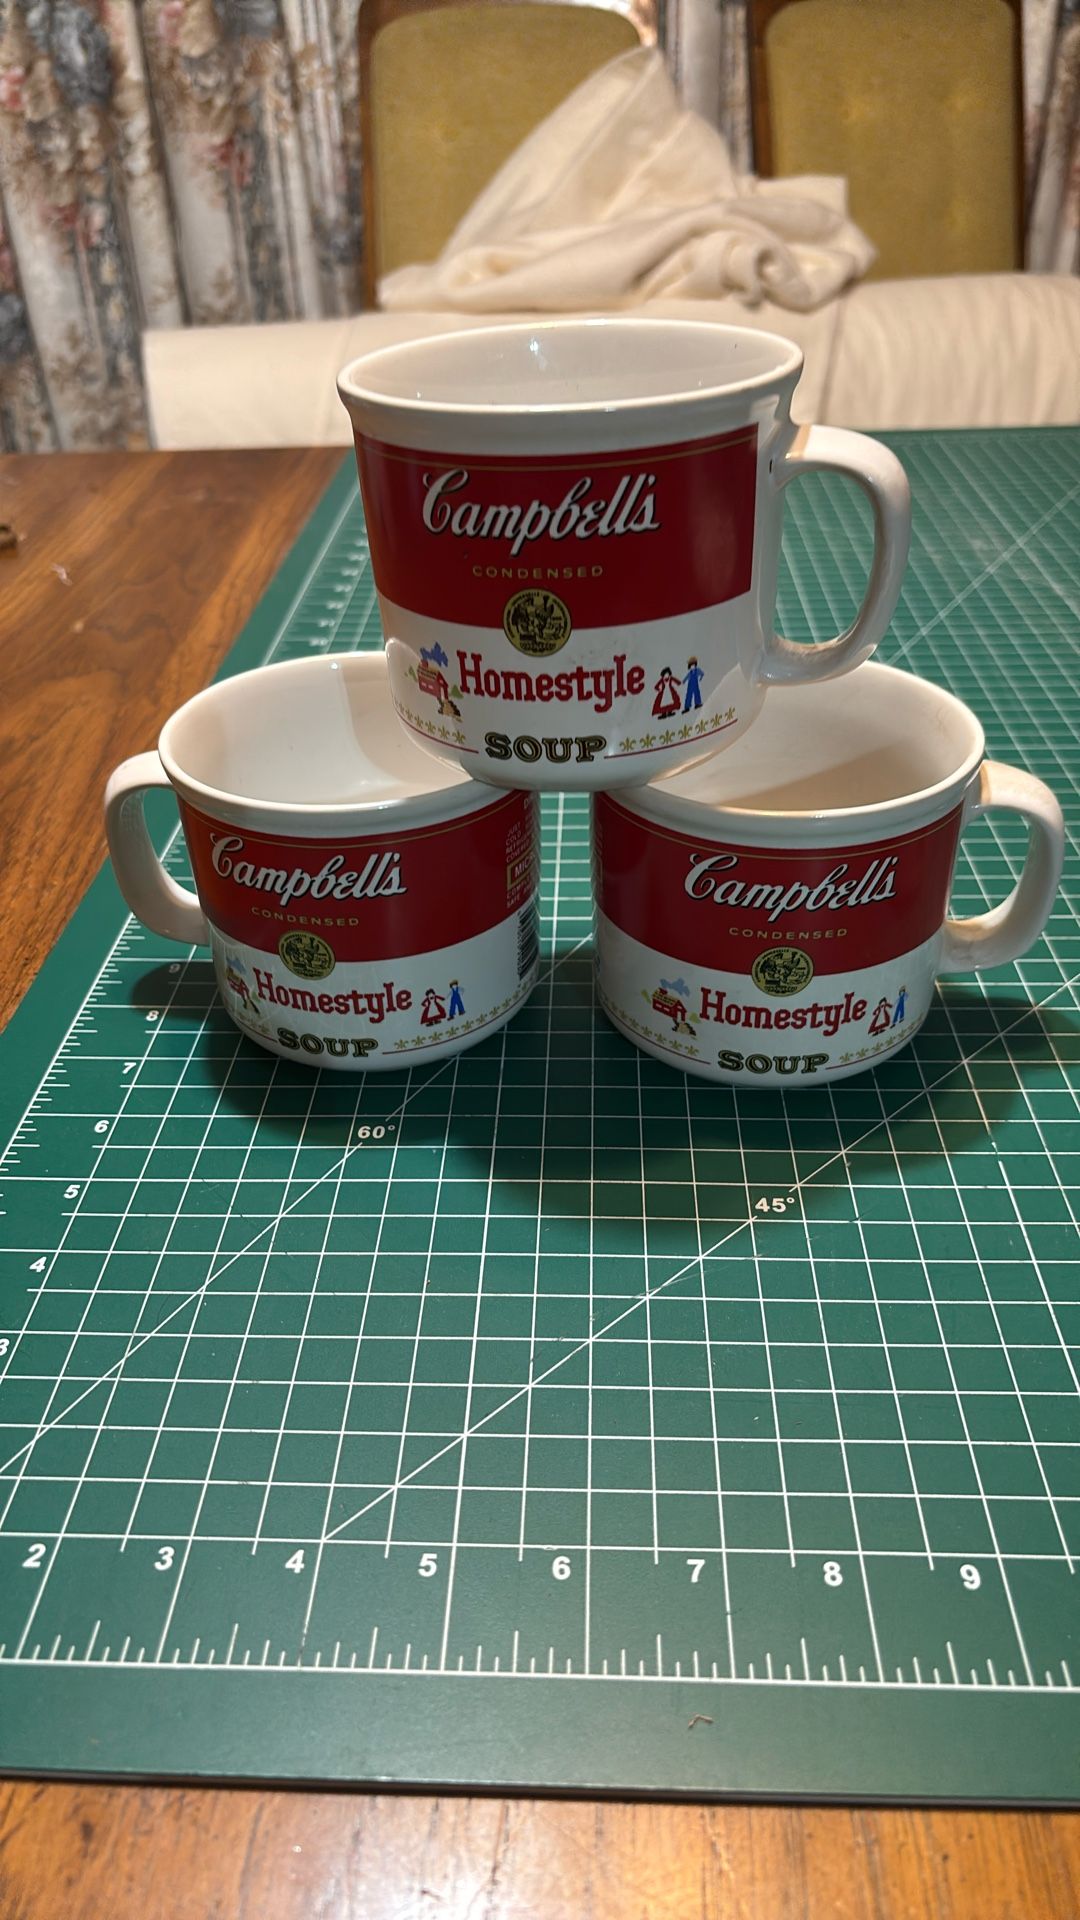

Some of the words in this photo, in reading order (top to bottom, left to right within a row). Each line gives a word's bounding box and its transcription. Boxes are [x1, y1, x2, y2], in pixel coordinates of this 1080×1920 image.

[422, 469, 660, 557] Campbell's
[472, 565, 604, 579] CONDENSED
[456, 650, 646, 713] Homestyle
[484, 731, 607, 763] SOUP
[209, 833, 408, 907] Campbell's
[683, 853, 899, 923] Campbell's
[251, 906, 360, 926] CONDENSED
[728, 927, 848, 941] CONDENSED
[168, 963, 182, 974] 9
[253, 967, 412, 1024] Homestyle
[145, 1009, 160, 1022] 8
[699, 986, 867, 1037] Homestyle
[276, 1027, 379, 1058] SOUP
[121, 1062, 137, 1075] 7
[717, 1050, 830, 1075] SOUP
[93, 1119, 110, 1135] 6
[357, 1124, 396, 1140] 60°
[63, 1184, 81, 1200] 5
[754, 1196, 796, 1213] 45°
[29, 1256, 47, 1273] 4
[22, 1543, 46, 1568] 2
[154, 1546, 175, 1571] 3
[284, 1549, 305, 1574] 4
[417, 1553, 438, 1577] 5
[551, 1555, 572, 1580] 6
[686, 1558, 706, 1583] 7
[822, 1561, 844, 1587] 8
[959, 1564, 982, 1590] 9
